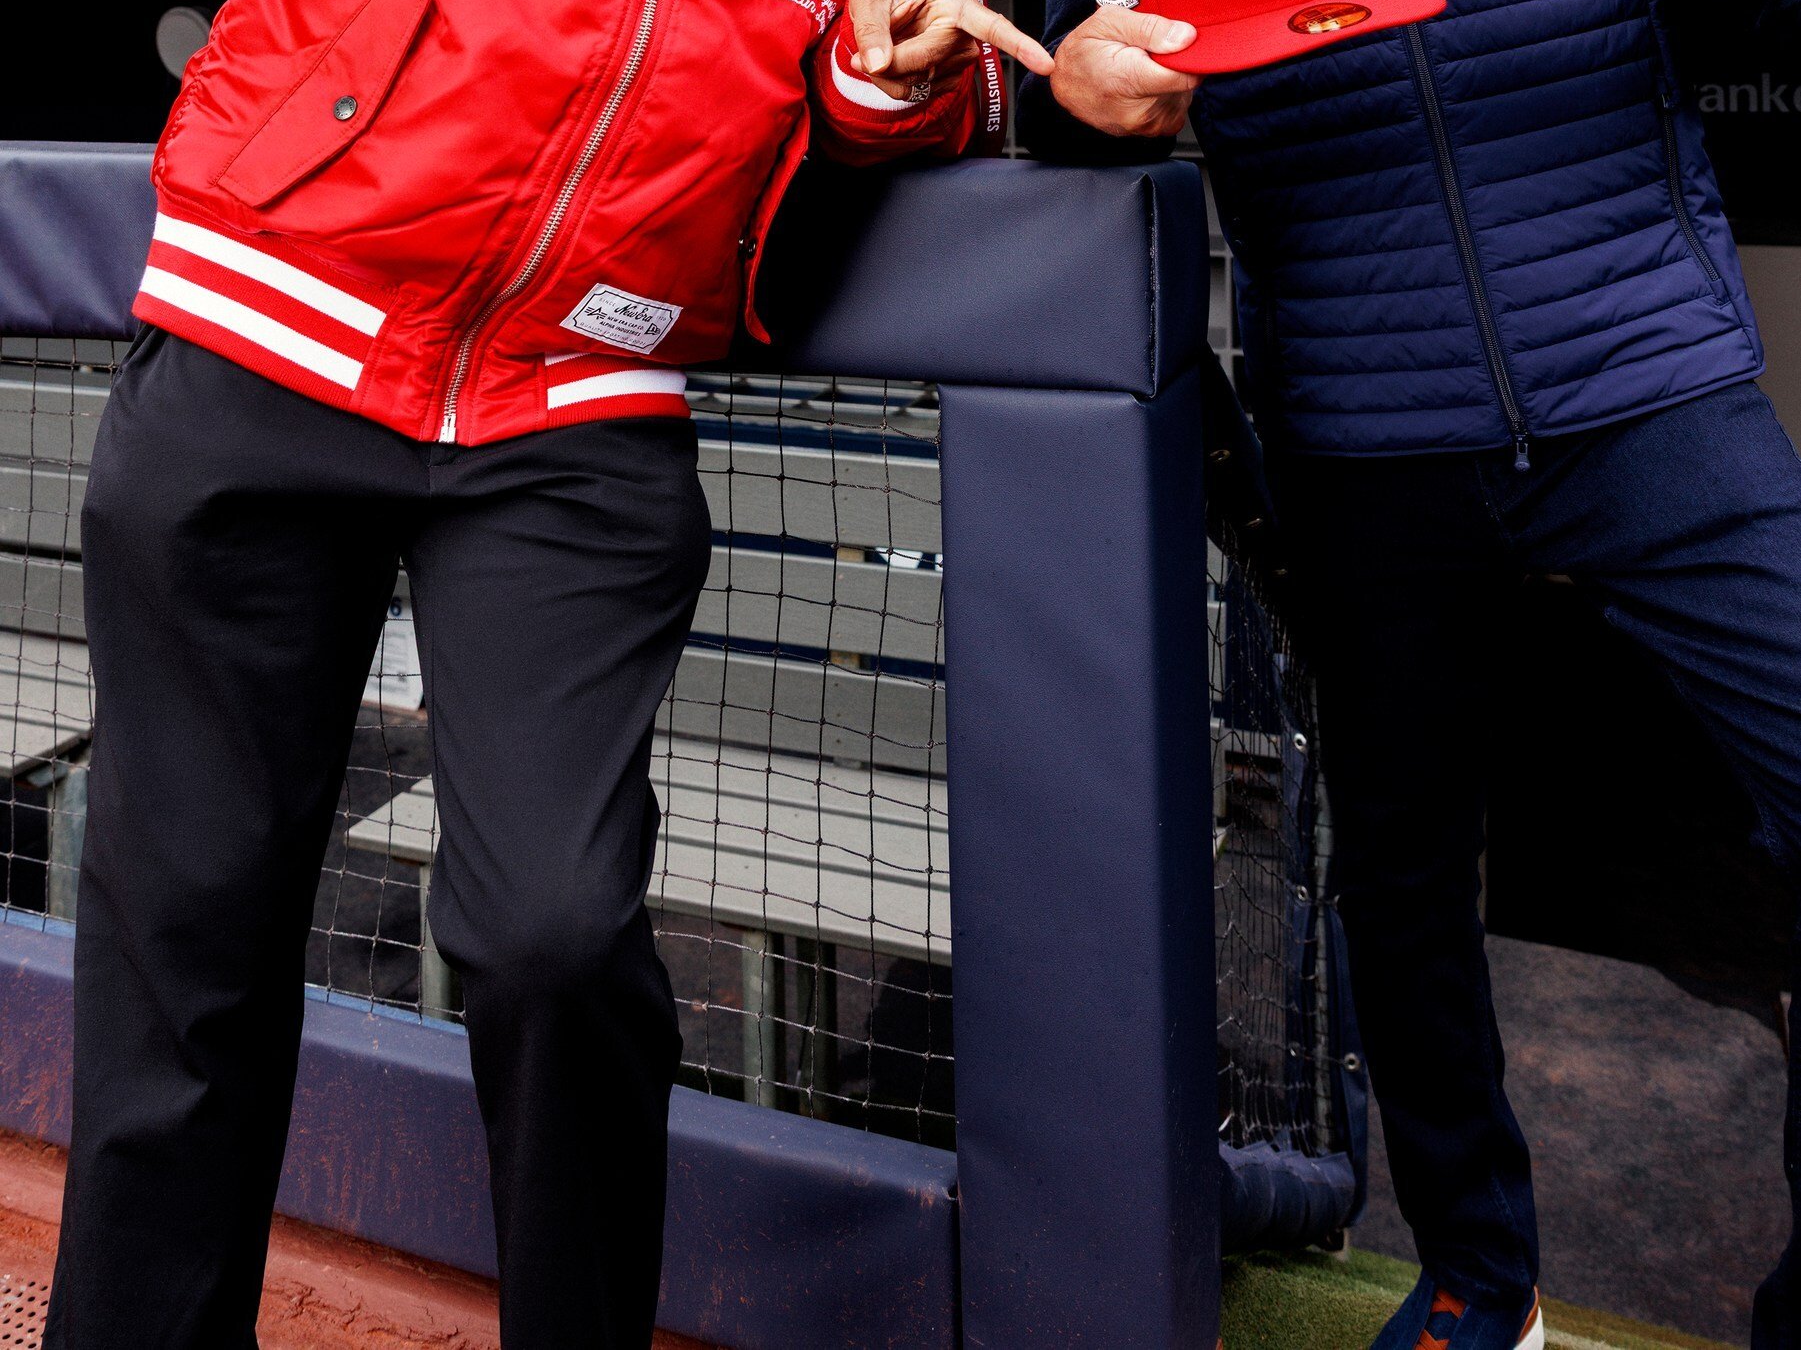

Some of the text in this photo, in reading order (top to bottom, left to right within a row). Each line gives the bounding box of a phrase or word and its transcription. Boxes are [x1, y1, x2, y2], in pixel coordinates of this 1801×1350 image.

[984, 58, 1001, 132] INDUSTRIES
[599, 321, 642, 337] ALPHA INDUSTRIES
